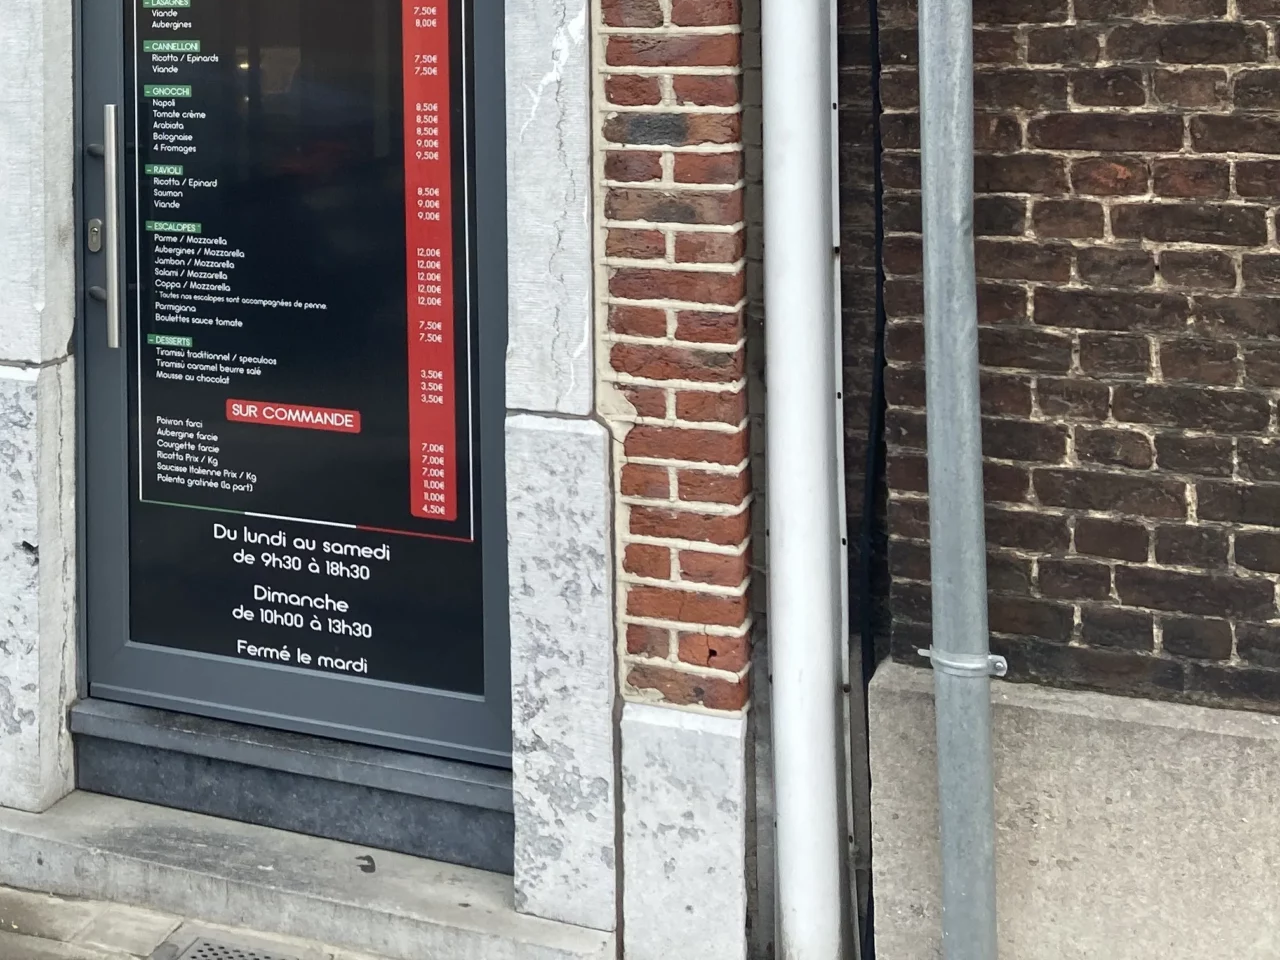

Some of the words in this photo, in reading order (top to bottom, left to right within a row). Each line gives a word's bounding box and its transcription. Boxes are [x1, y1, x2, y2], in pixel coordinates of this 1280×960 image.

[152, 9, 178, 17] Viande
[152, 21, 192, 30] Aubergines
[152, 54, 178, 62] Ricotta
[187, 54, 219, 63] Epinards
[152, 88, 190, 96] GNOCCHI
[152, 99, 176, 108] Napoli
[153, 110, 180, 118] Tomate
[182, 110, 206, 118] crème
[153, 132, 193, 142] Bolognaise
[161, 144, 196, 154] Fromages
[153, 166, 182, 175] RAVIOLI
[153, 178, 180, 186] Ricotta
[189, 179, 218, 188] Epinard
[154, 189, 183, 197] Saumon
[154, 200, 180, 208] Viande
[154, 234, 177, 243] Parme
[187, 235, 227, 245] Mozzarella
[155, 245, 194, 256] Aubergines
[204, 247, 245, 258] Mozzarella
[155, 257, 186, 266] Jambon
[155, 268, 178, 277] Salami
[187, 270, 227, 280] Mozzarella
[155, 279, 181, 289] Coppa
[190, 281, 231, 291] Mozzarella
[155, 302, 197, 313] Parmigiana
[155, 313, 190, 323] Boulettes
[191, 317, 213, 325] sauce
[215, 316, 243, 327] tomate
[156, 336, 191, 346] DESSERTS
[156, 347, 185, 358] Tiramisù
[187, 350, 230, 361] traditionnel
[239, 355, 277, 365] speculoos
[156, 359, 185, 369] Tiramisù
[187, 362, 218, 372] caramel
[220, 364, 244, 374] beurre
[246, 365, 261, 376] salé
[156, 371, 183, 380] Mousse
[197, 373, 230, 385] chocolat
[157, 416, 183, 427] Poivron
[185, 419, 203, 428] farci
[232, 404, 258, 418] SUR
[263, 406, 354, 428] COMMANDE
[157, 428, 194, 440] Aubergine
[197, 431, 218, 441] farcie
[157, 439, 195, 451] Courgette
[198, 443, 219, 453] farcie
[157, 451, 184, 461] Ricotta
[186, 454, 199, 463] Prix
[208, 456, 218, 467] Kg
[157, 462, 187, 473] Saucisse
[189, 466, 221, 477] Italienne
[157, 474, 185, 484] Polenta
[187, 478, 219, 488] gratinée
[213, 523, 237, 541] Du
[244, 526, 287, 547] lundi
[293, 538, 315, 550] au
[323, 541, 390, 561] samedi
[233, 549, 255, 564] de
[261, 553, 302, 571] 9h30
[308, 557, 320, 574] à
[326, 560, 370, 580] 18h30
[254, 585, 349, 613] Dimanche
[232, 605, 254, 620] de
[260, 608, 303, 628] 10h00
[310, 615, 321, 631] à
[328, 618, 372, 638] 13h30
[237, 639, 291, 661] Fermé
[297, 648, 311, 664] le
[318, 657, 368, 673] mardi
